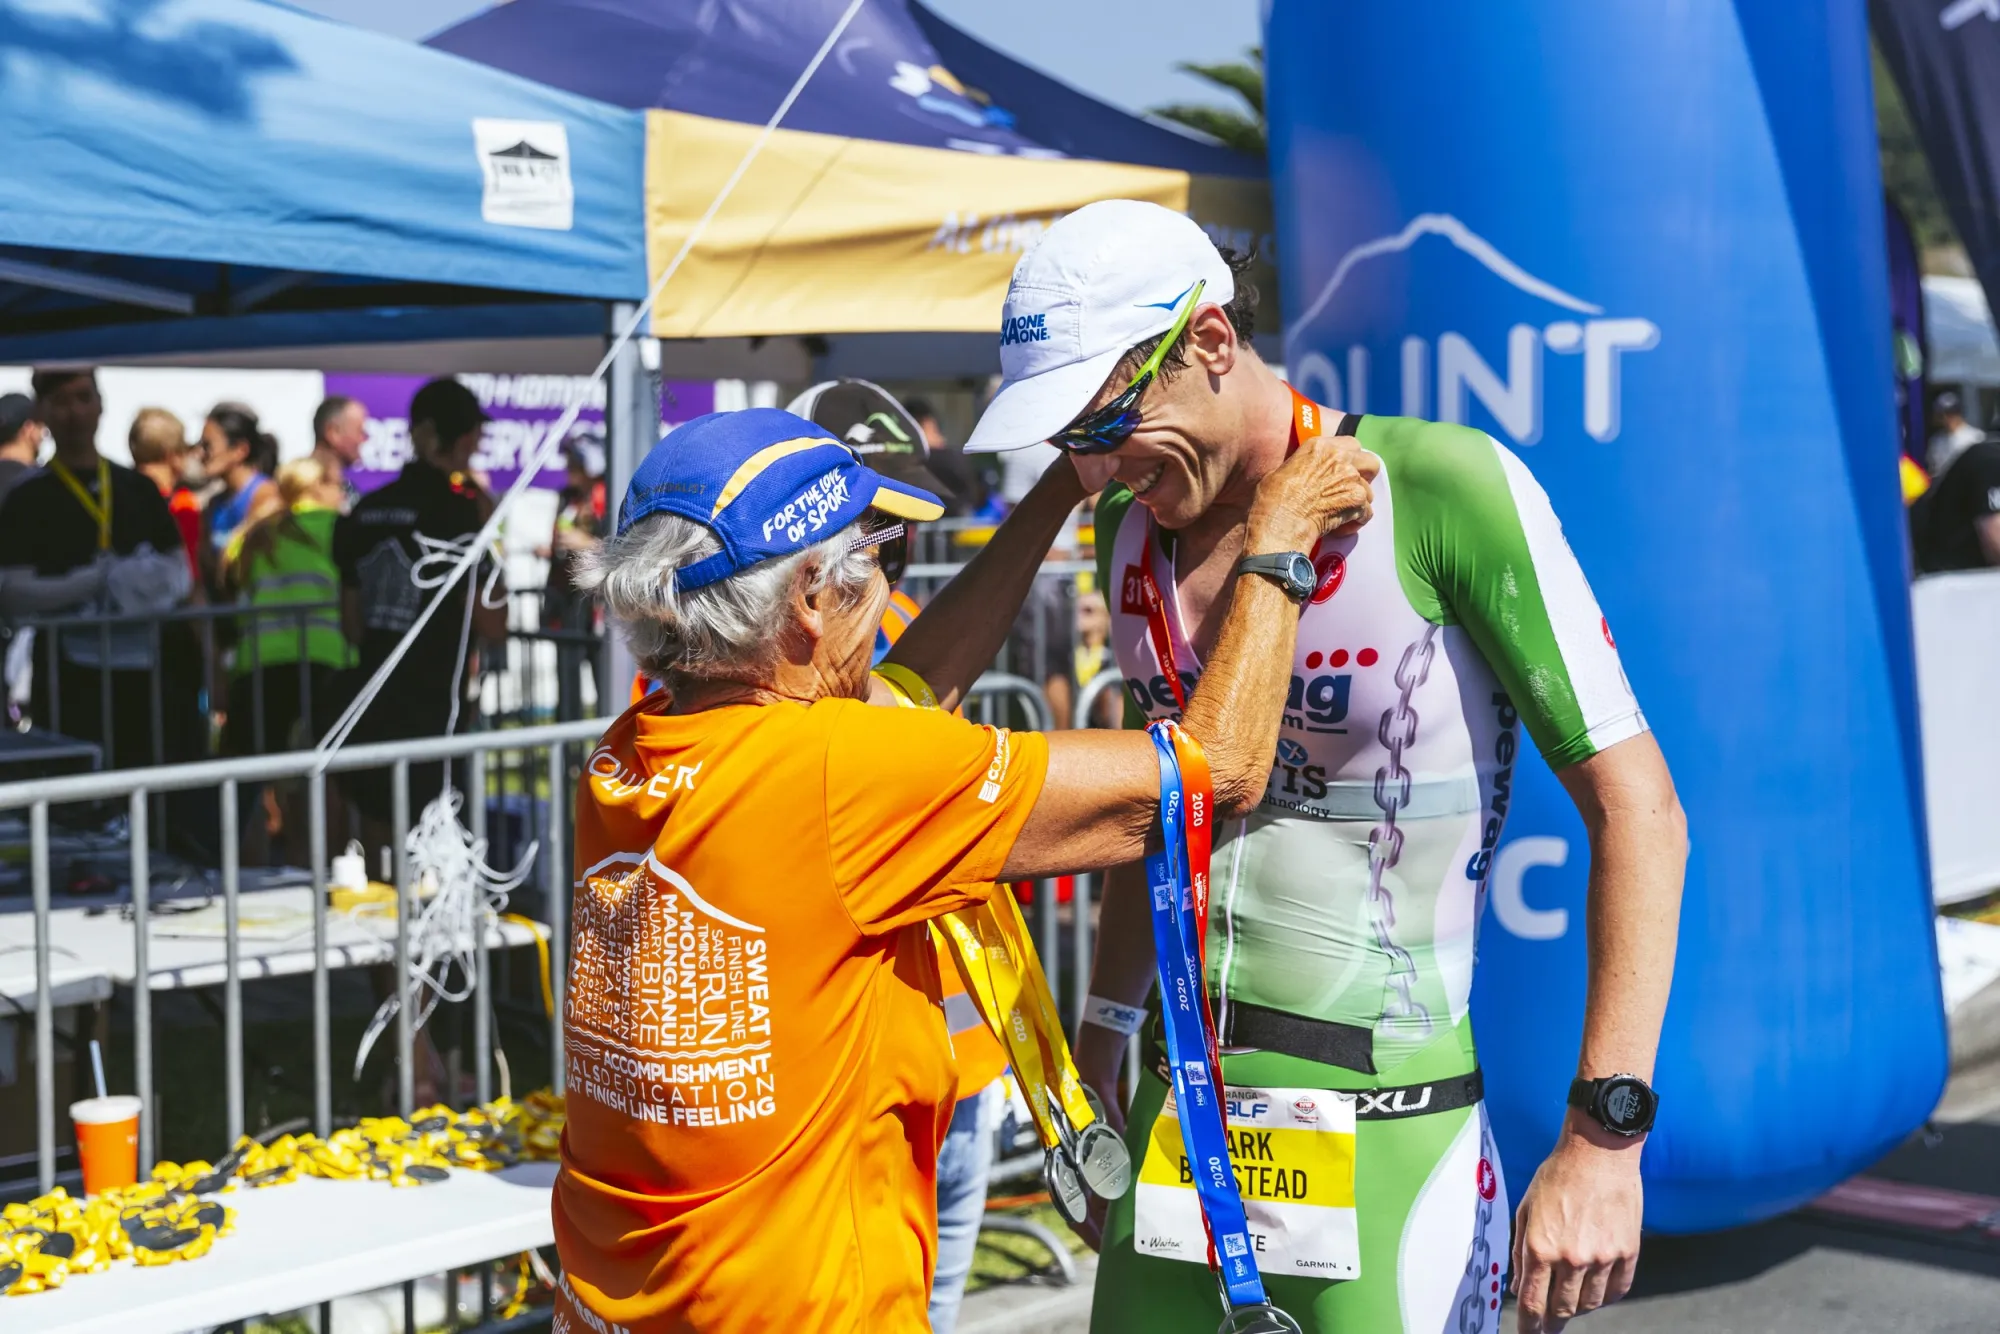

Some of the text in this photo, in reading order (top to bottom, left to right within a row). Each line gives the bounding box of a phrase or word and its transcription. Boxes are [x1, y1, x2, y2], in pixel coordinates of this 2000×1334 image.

[1017, 313, 1046, 330] ONE
[1019, 327, 1048, 343] ONE
[1302, 404, 1314, 430] 2020
[762, 465, 842, 543] FOR THE LOVE
[787, 475, 851, 543] OF SPORT
[1162, 651, 1176, 683] 2020
[1166, 790, 1181, 824] 2020
[1191, 792, 1205, 828] 2020
[1465, 692, 1518, 881] pewag
[595, 871, 620, 978] SUNSHINE
[697, 922, 711, 971] TIMING
[615, 941, 623, 994] PILOT
[622, 945, 632, 998] SWIM
[639, 876, 662, 1046] JANUARY BIKE
[660, 894, 678, 1047] MAUNGANUI
[711, 929, 726, 970] SAND
[574, 974, 588, 1024] RACE
[601, 959, 616, 1034] FAST
[630, 954, 641, 1041] FESTIVAL
[679, 911, 698, 1047] MOUNT TRI
[727, 936, 747, 1042] FINISH LINE
[745, 939, 771, 1036] SWEAT
[1176, 977, 1190, 1012] 2020
[613, 1002, 621, 1036] BAY
[621, 999, 631, 1040] SUN
[699, 973, 728, 1045] RUN
[1010, 1008, 1028, 1042] 2020
[600, 1067, 775, 1106] DEDICATION
[603, 1049, 772, 1084] ACCOMPLISHMENT
[585, 1080, 628, 1114] FINISH
[629, 1099, 669, 1124] LINE
[673, 1095, 777, 1127] FEELING
[1228, 1129, 1275, 1162] ARK
[1208, 1156, 1227, 1188] 2020
[1296, 1259, 1338, 1270] GARMIN
